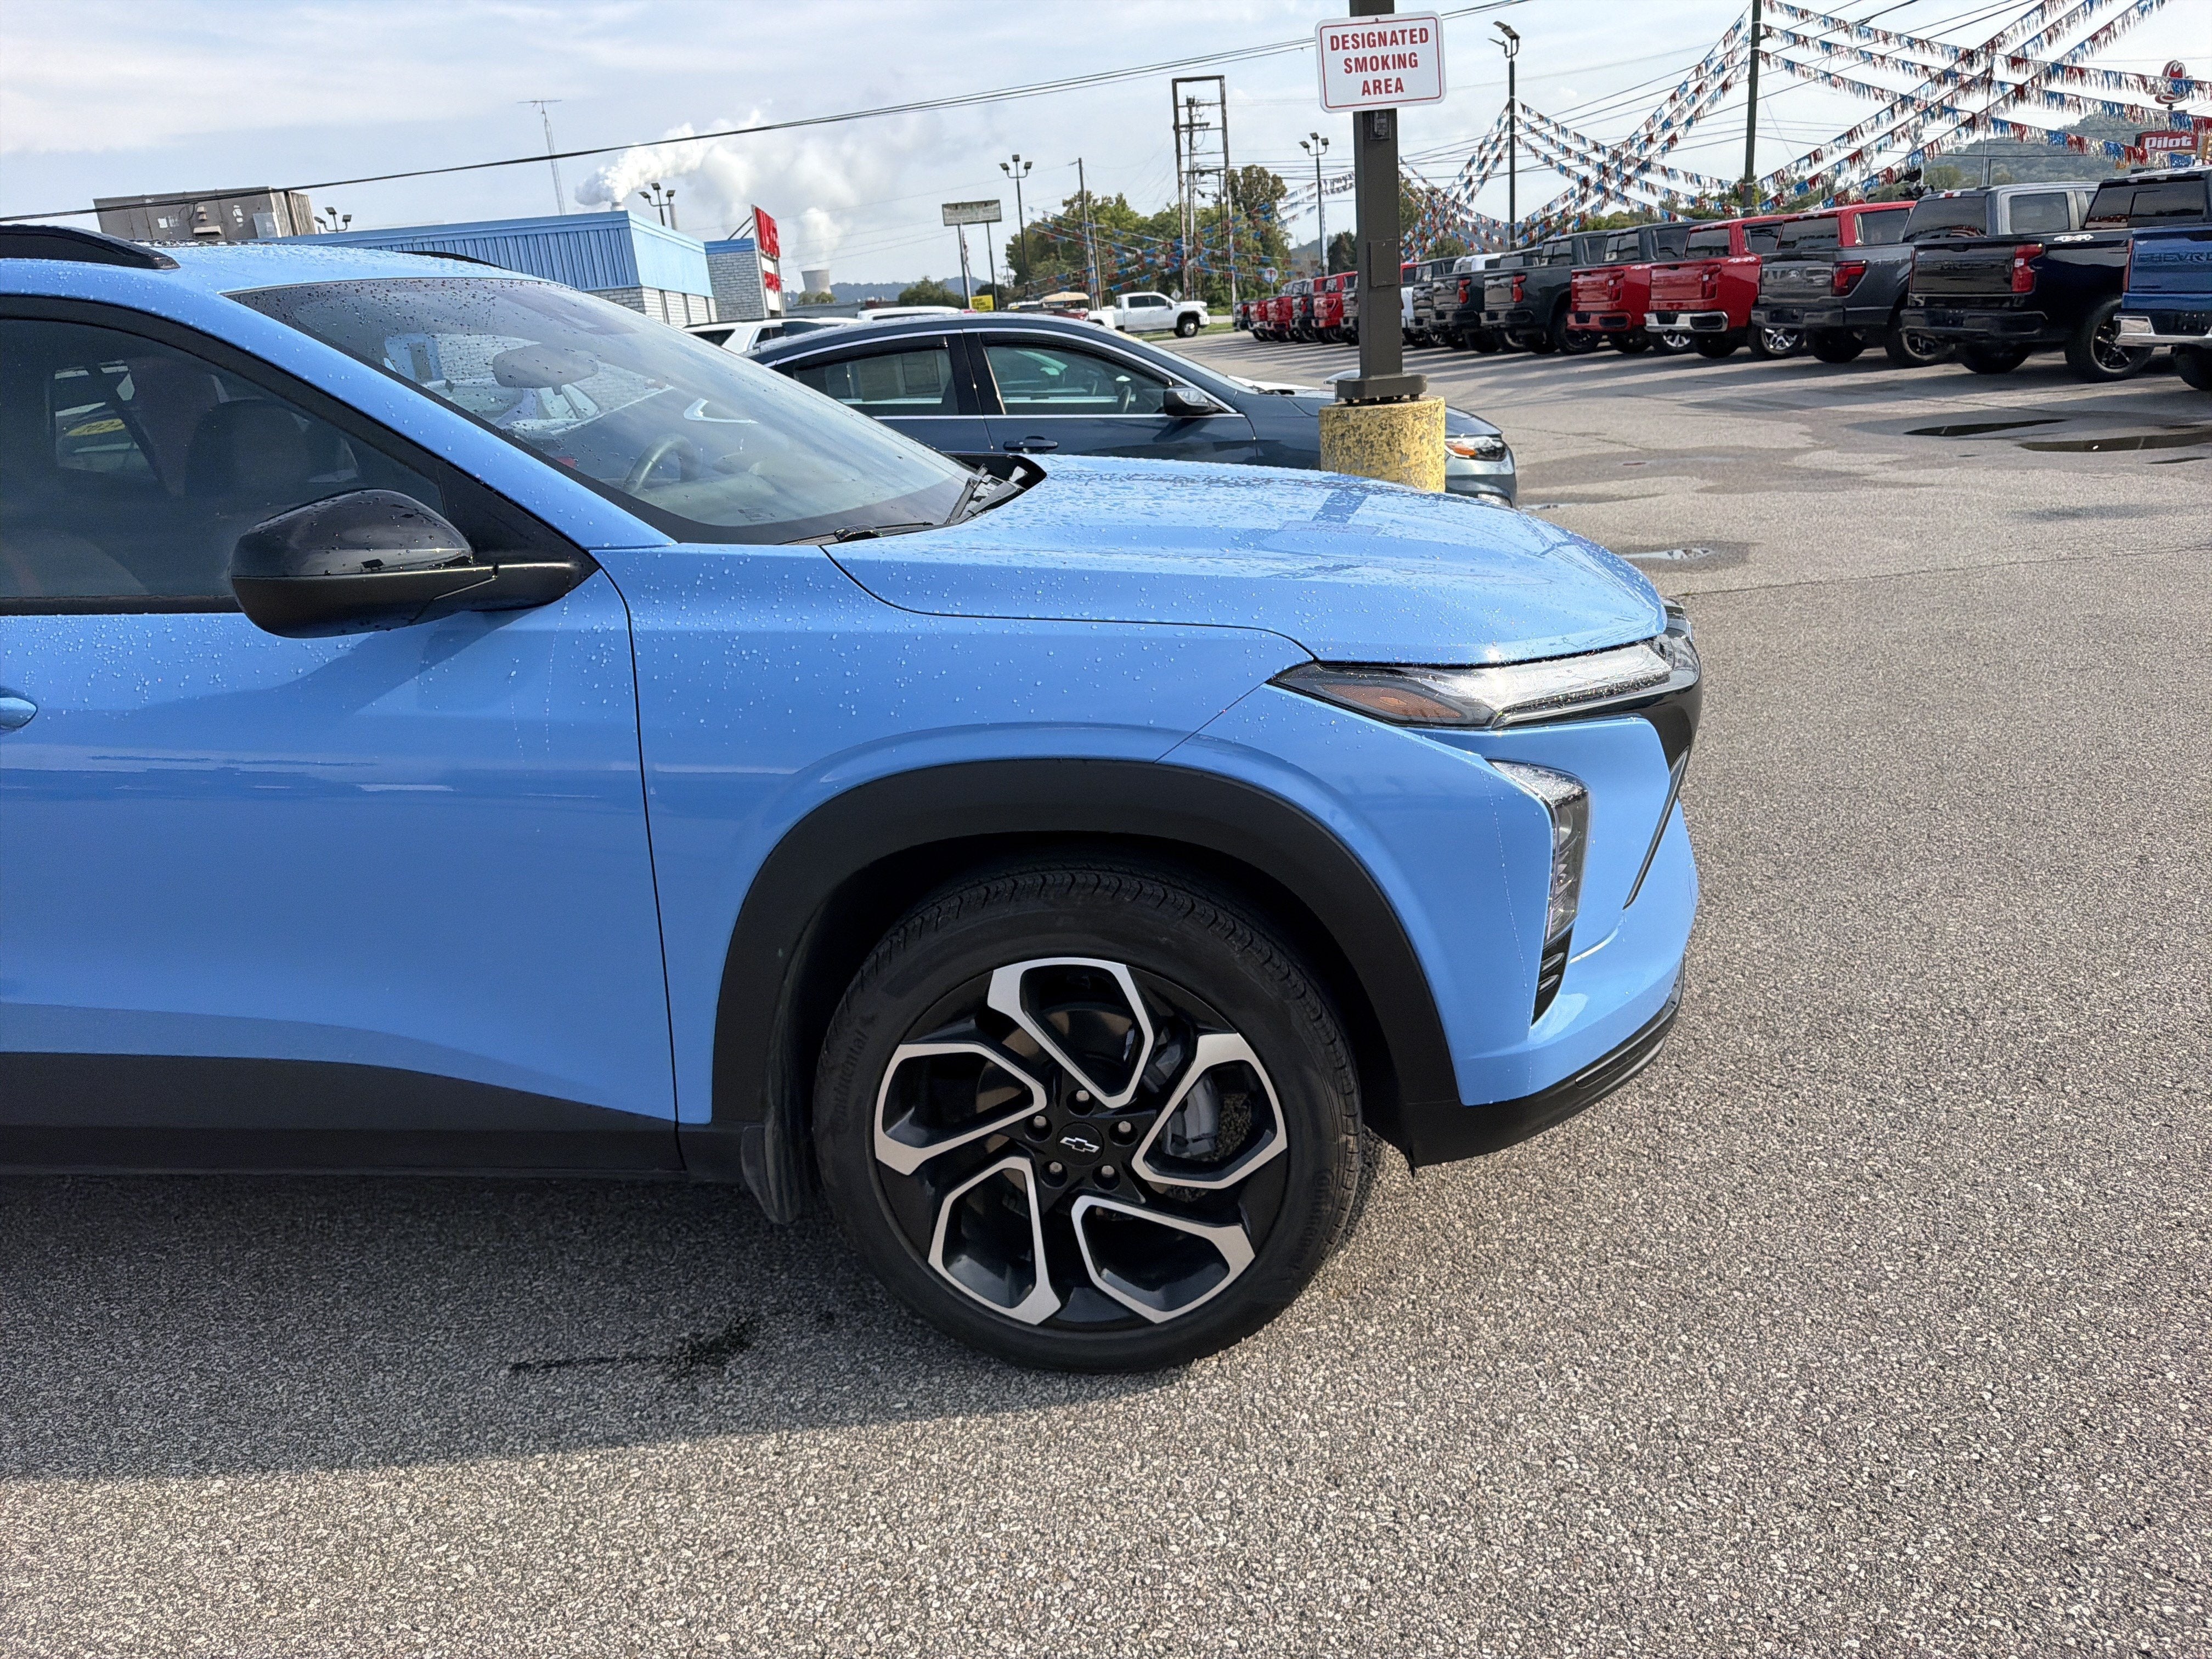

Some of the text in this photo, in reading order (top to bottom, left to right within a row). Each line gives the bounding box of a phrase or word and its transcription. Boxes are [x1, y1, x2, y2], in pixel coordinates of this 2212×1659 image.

[1330, 27, 1429, 51] DESIGNATED
[1344, 52, 1419, 74] SMOKING
[1361, 77, 1404, 96] AREA
[2145, 136, 2193, 150] Pilot
